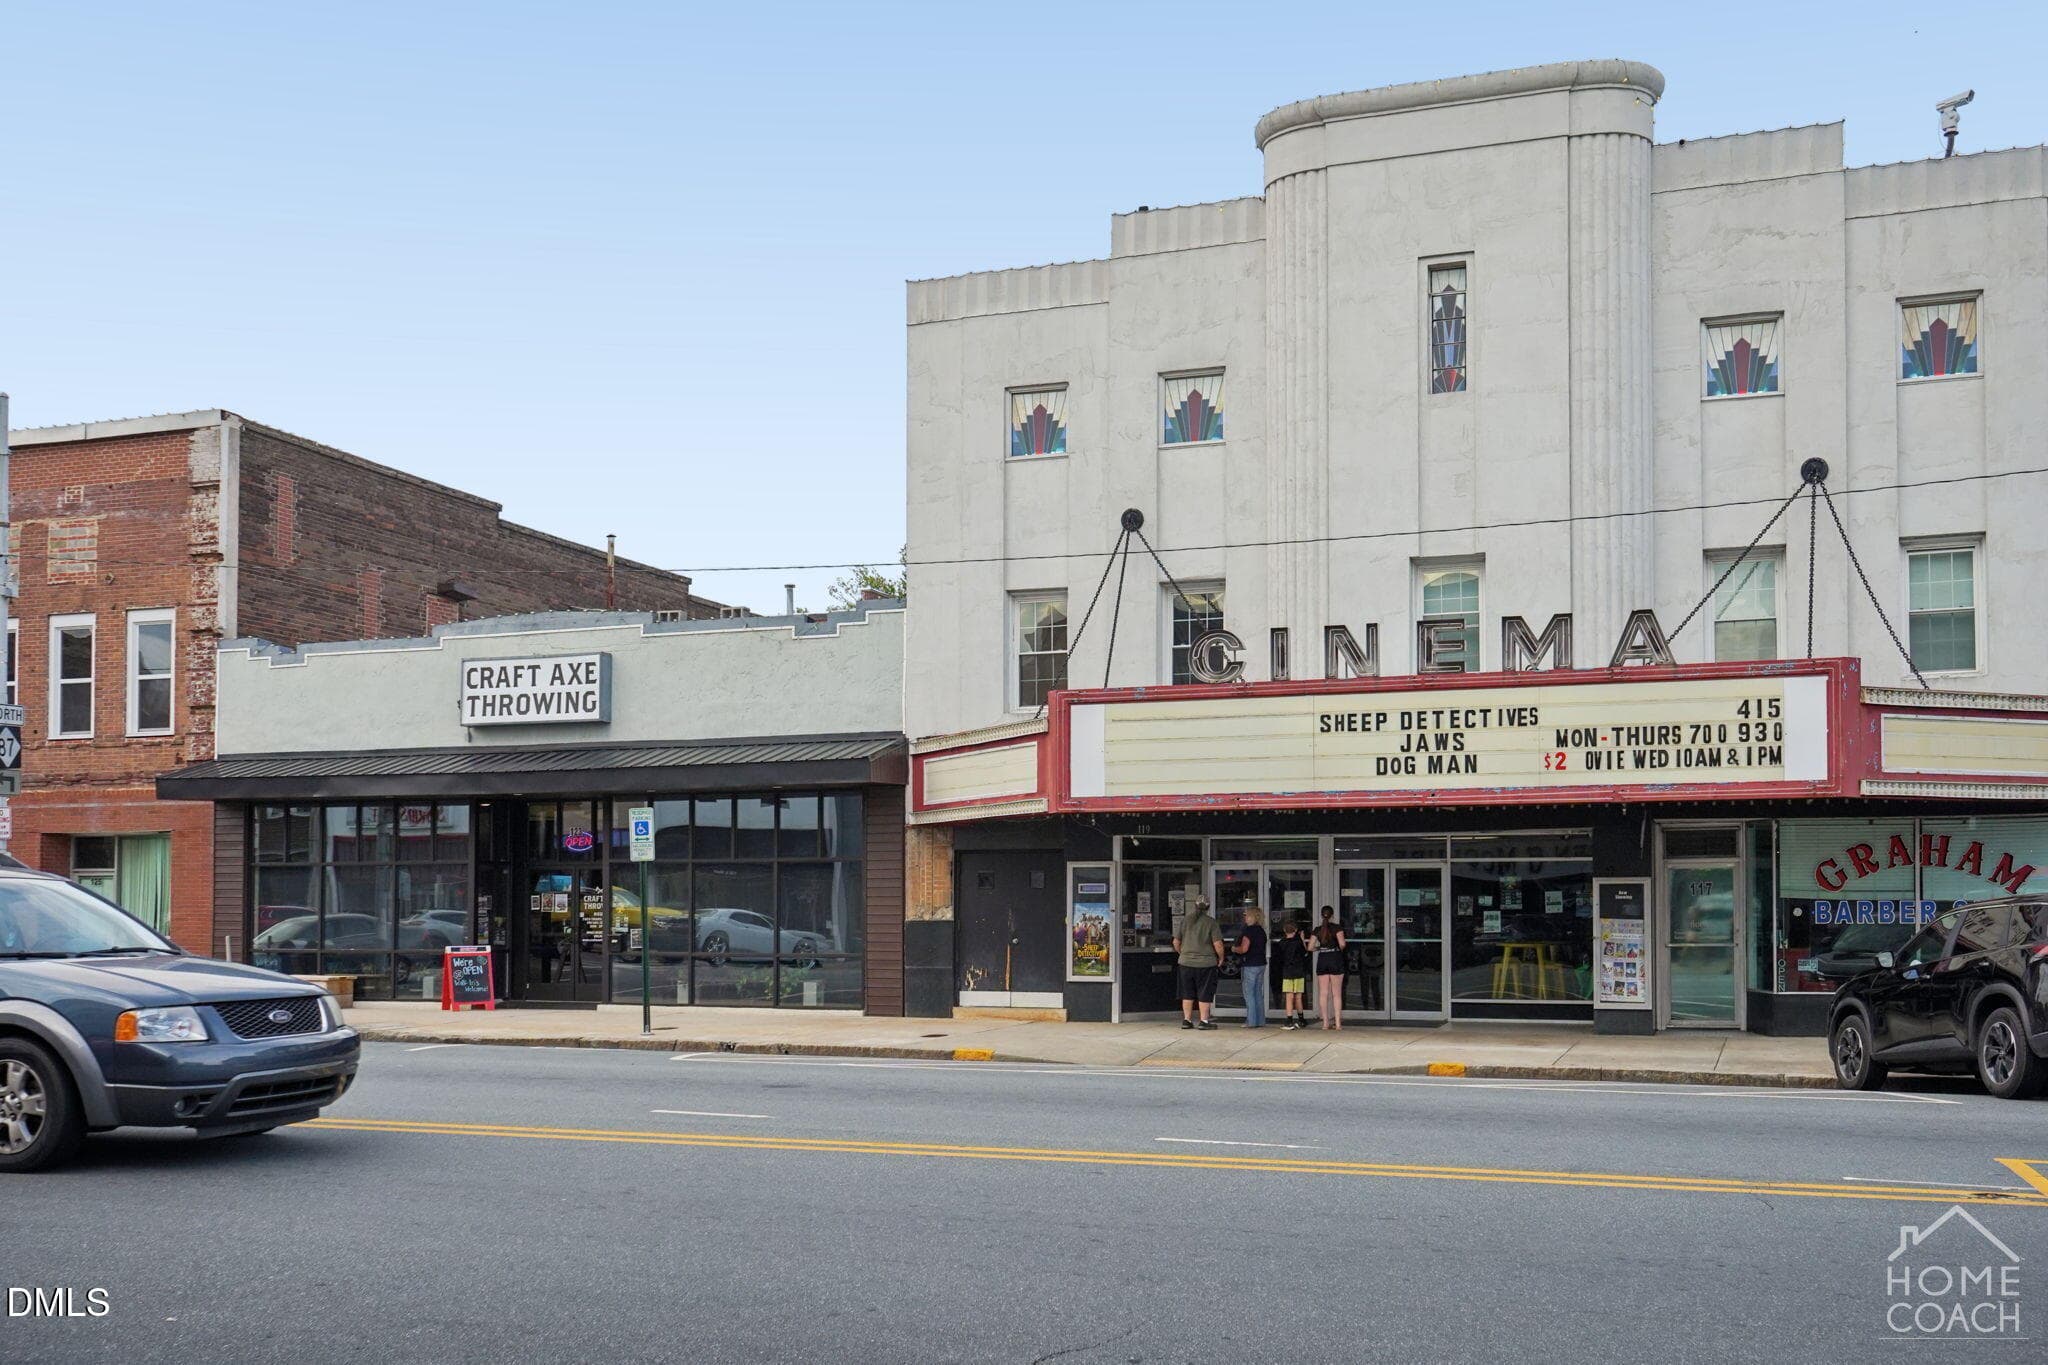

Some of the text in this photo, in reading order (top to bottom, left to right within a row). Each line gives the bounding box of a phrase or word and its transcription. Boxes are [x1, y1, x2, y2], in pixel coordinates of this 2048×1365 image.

[1187, 609, 1677, 684] CINEMA
[466, 661, 597, 689] CRAFT AXE
[466, 690, 597, 718] THROWING
[1737, 698, 1781, 719] 415
[1320, 707, 1538, 733] SHEEP DETECTIVES
[1400, 732, 1465, 752] JAWS
[1690, 724, 1726, 744] 700
[1738, 722, 1782, 742] 930
[1376, 754, 1478, 776] DOG MAN
[1544, 752, 1567, 770] $2
[1586, 750, 1624, 770] OVIE
[1633, 749, 1669, 768] WED
[1727, 748, 1739, 766] &
[566, 836, 592, 846] OPEN
[1814, 833, 2037, 895] GRAHAM
[1690, 882, 1712, 896] 117
[1814, 900, 1937, 924] BARBER
[462, 966, 484, 975] OPEN
[1778, 958, 1786, 992] OPEN
